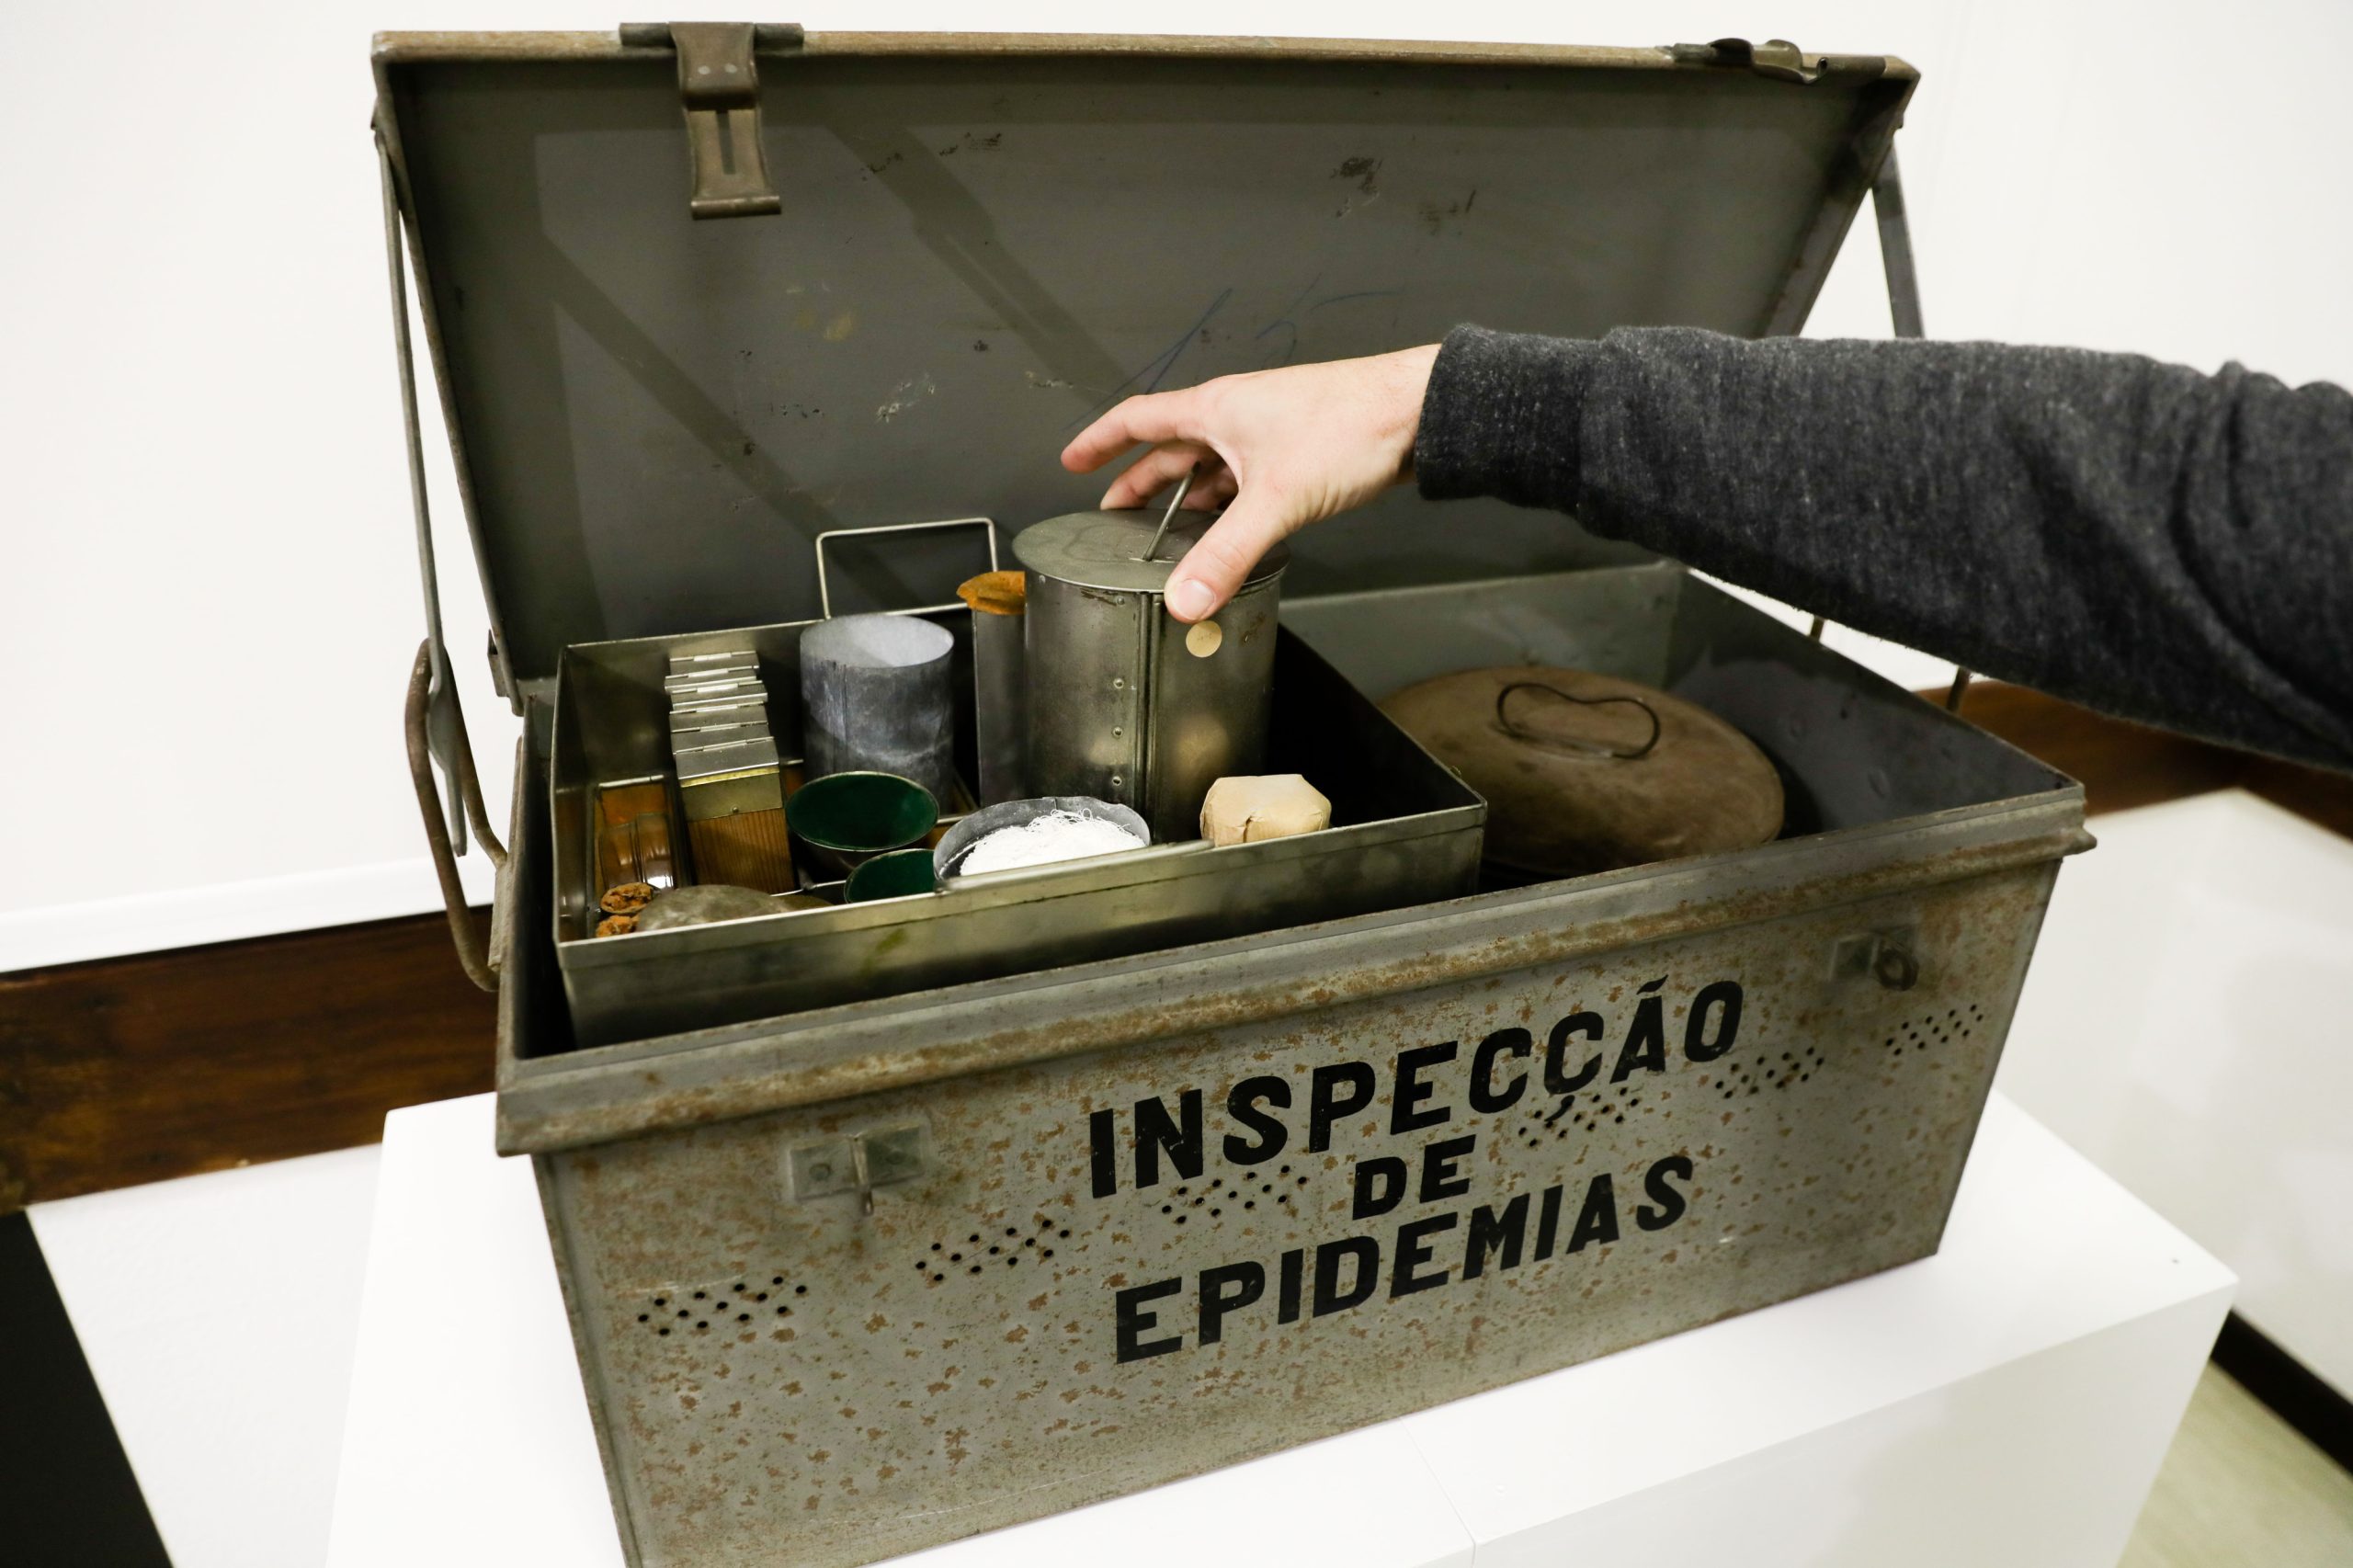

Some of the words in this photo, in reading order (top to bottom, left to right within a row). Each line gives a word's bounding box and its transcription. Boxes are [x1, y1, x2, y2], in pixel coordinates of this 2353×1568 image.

[1089, 975, 1744, 1199] INSPECÇÃO
[1352, 1133, 1477, 1221] DE
[1116, 1155, 1693, 1364] EPIDEMIAS
